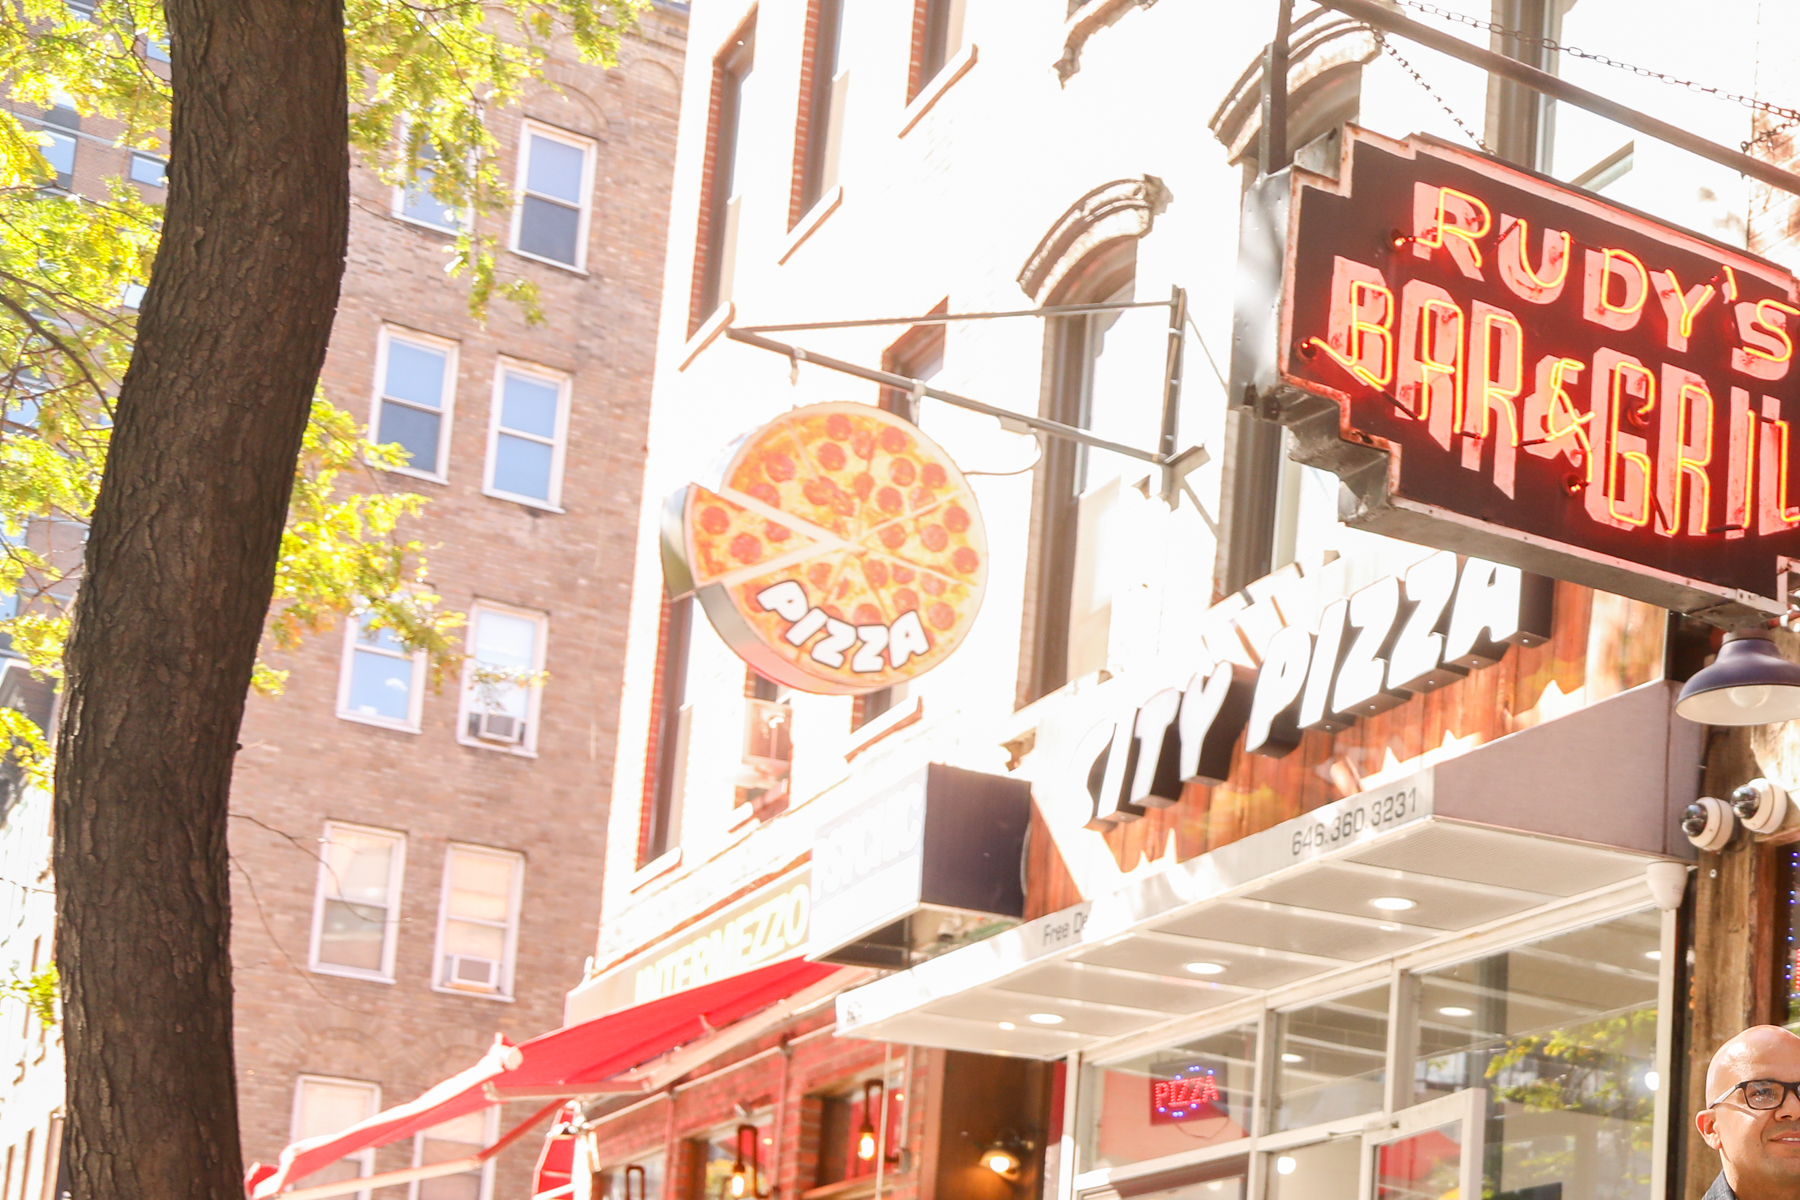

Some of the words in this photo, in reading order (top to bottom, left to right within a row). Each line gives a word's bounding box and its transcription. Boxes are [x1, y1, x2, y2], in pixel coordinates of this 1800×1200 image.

[756, 579, 931, 674] PIZZA
[1244, 549, 1523, 753] PIZZA
[1291, 787, 1419, 857] 646.360.3231
[634, 883, 810, 1002] INTERMEZZO
[1042, 920, 1070, 947] Free
[1154, 1075, 1219, 1109] PIZZA
